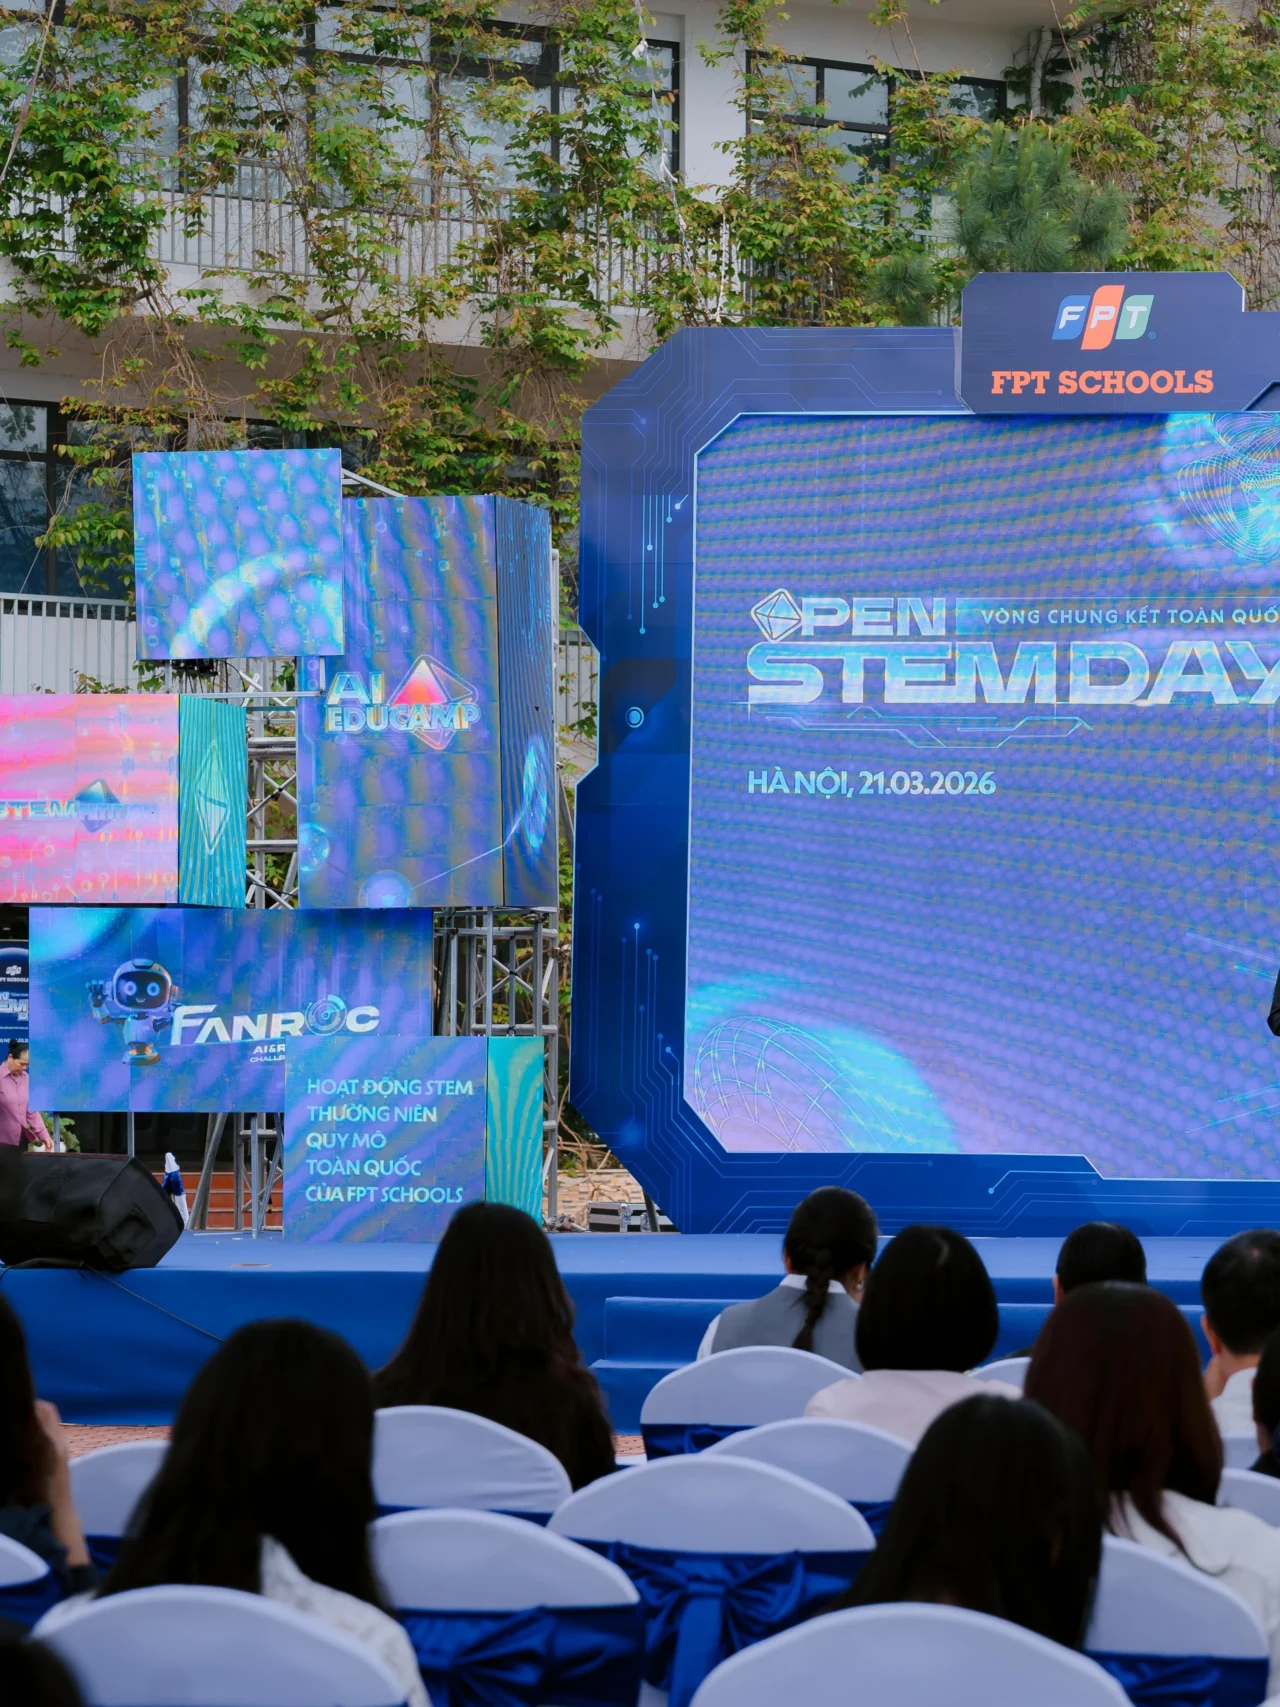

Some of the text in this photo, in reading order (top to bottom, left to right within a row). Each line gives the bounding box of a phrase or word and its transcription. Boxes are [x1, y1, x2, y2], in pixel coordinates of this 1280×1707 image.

[991, 369, 1214, 394] FPT SCHOOLS
[981, 606, 1041, 624] VÒNG
[1047, 608, 1118, 624] CHUNG
[1125, 605, 1161, 624] KẾT
[1167, 605, 1224, 624] TOÀN
[326, 672, 385, 705] AI
[325, 703, 482, 733] EDUCAMP
[748, 765, 997, 799] HÀ NỘI, 21.03.2026
[307, 1076, 474, 1099] HOẠT ĐỘNG STEM
[306, 1103, 437, 1122] THƯỜNG NIÊN
[306, 1130, 387, 1150] QUY MÔ
[306, 1155, 422, 1178] TOÀN QUỐC
[305, 1182, 464, 1203] CỦA FPT SCHOOLS
